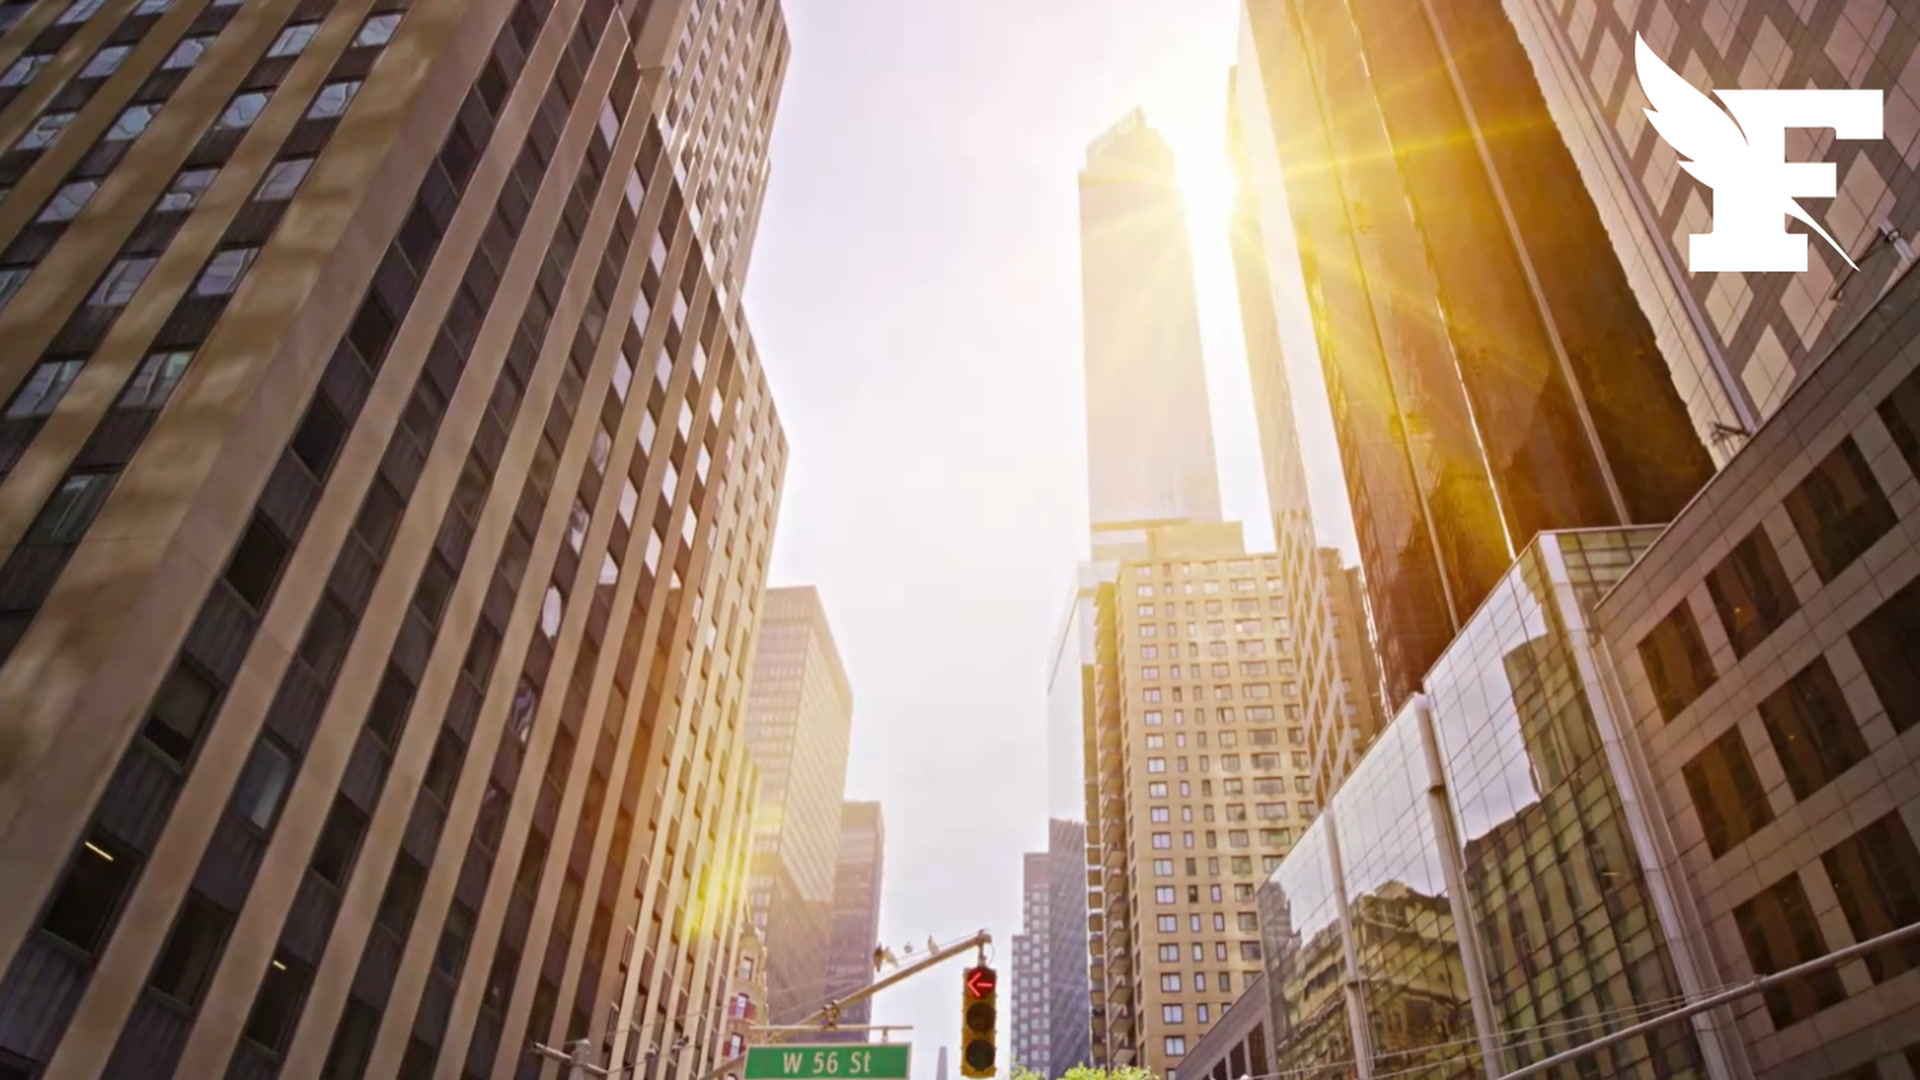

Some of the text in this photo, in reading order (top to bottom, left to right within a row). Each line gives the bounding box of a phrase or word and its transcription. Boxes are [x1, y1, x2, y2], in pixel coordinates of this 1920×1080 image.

[783, 1051, 872, 1074] W 56 St
